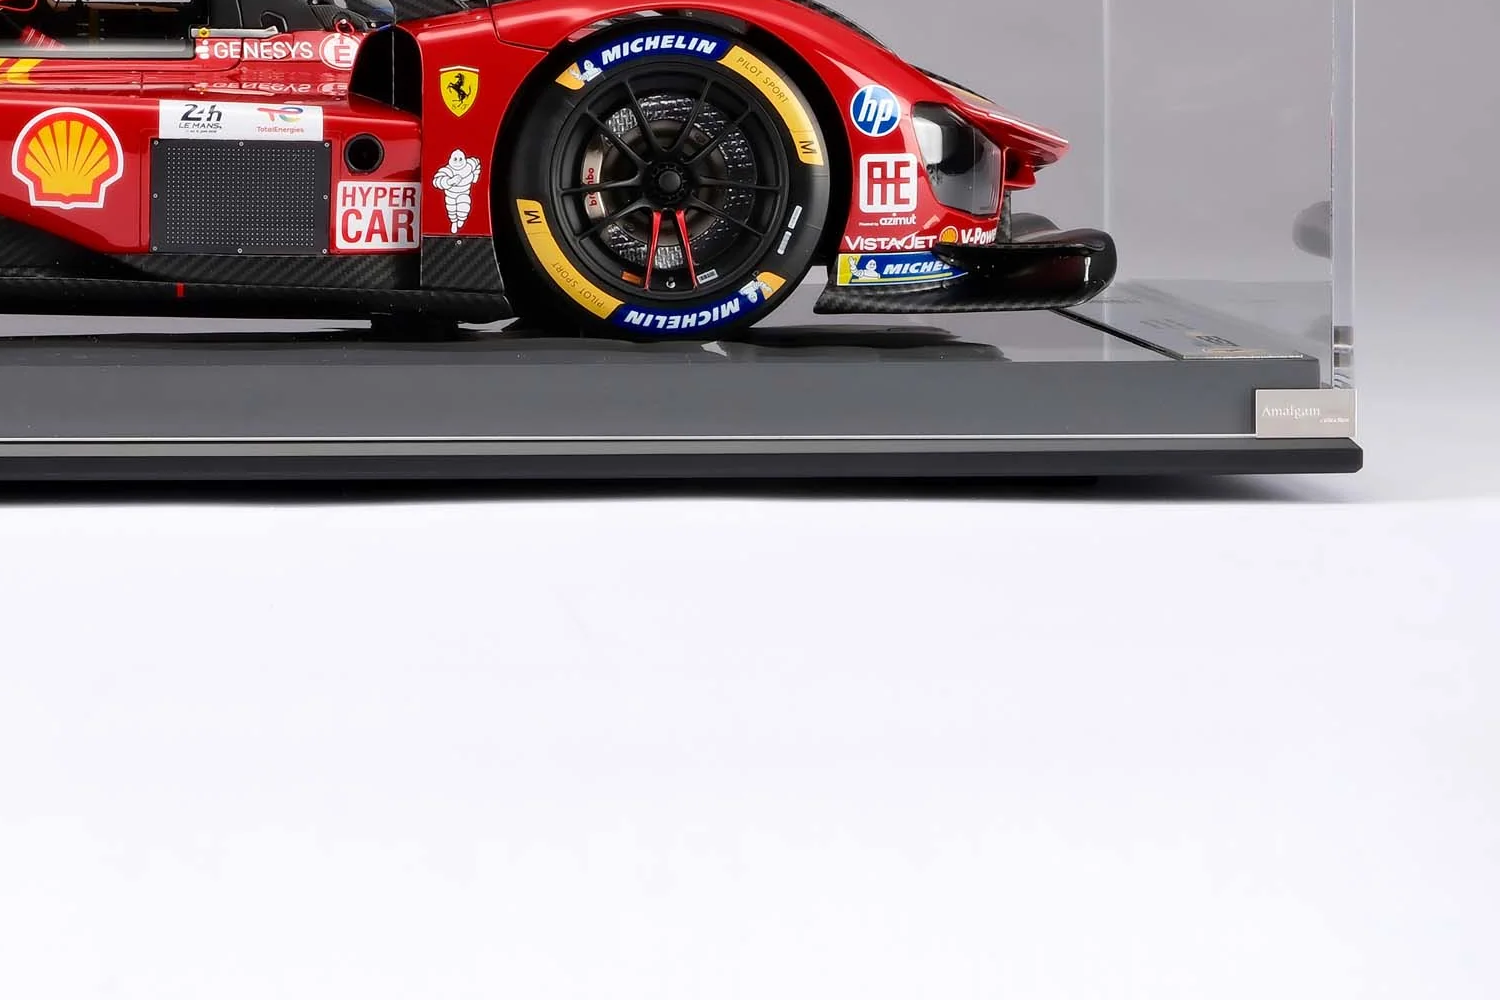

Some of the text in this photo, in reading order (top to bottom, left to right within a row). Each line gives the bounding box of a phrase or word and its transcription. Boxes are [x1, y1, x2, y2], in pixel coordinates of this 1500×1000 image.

[213, 41, 314, 60] GENESYS
[601, 34, 718, 66] MICHELIN
[736, 56, 790, 103] PILOT SPORT
[857, 86, 893, 136] hp
[257, 126, 305, 134] TotalEnergies
[799, 139, 818, 155] M
[341, 186, 417, 208] HYPER
[340, 208, 416, 244] CAR
[523, 209, 542, 225] M
[879, 212, 917, 226] azimut
[551, 262, 605, 308] PILOT SPORT
[623, 296, 742, 330] MICHELIN
[1261, 403, 1321, 421] Amalgam
